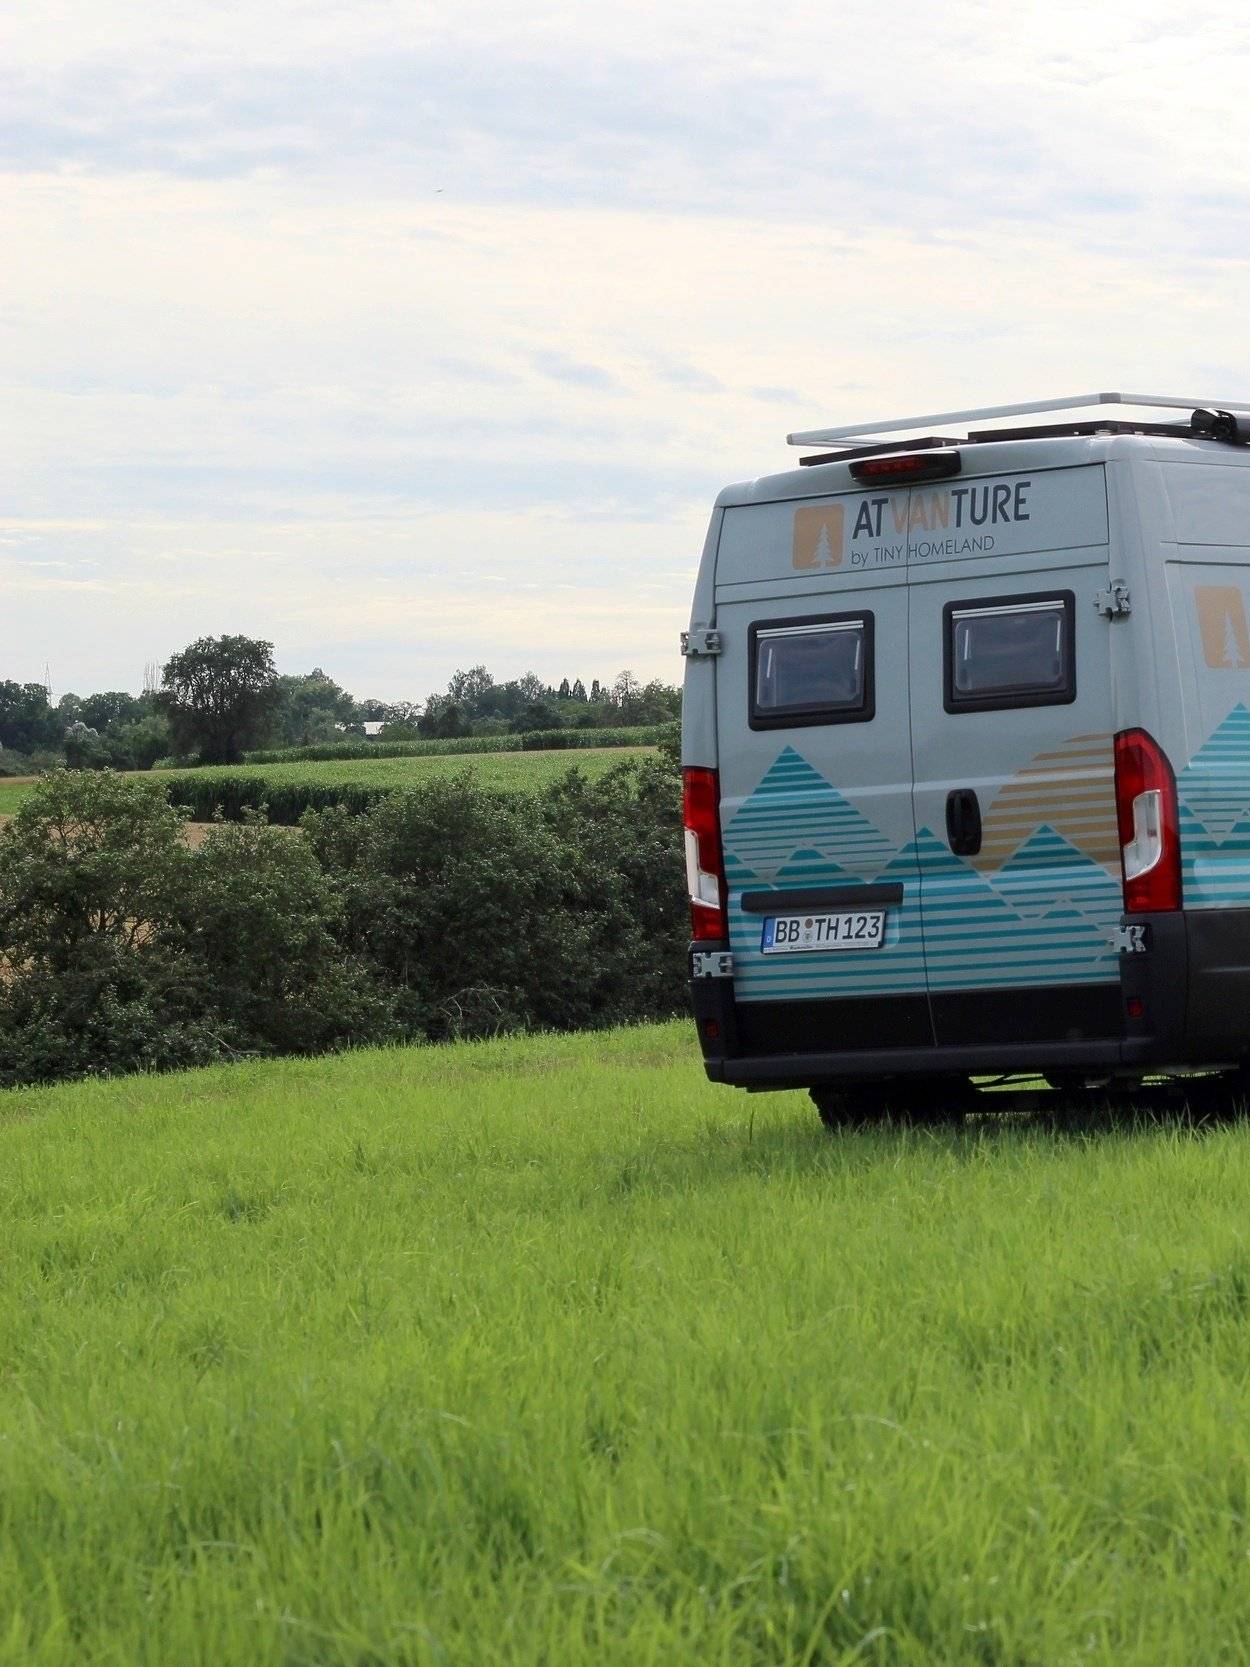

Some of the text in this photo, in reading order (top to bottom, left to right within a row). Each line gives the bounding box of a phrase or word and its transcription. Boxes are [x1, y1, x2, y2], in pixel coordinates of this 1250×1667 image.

[852, 481, 1031, 539] ATVANTURE
[850, 535, 995, 567] by TINY HOMELAND
[775, 920, 800, 943] BB
